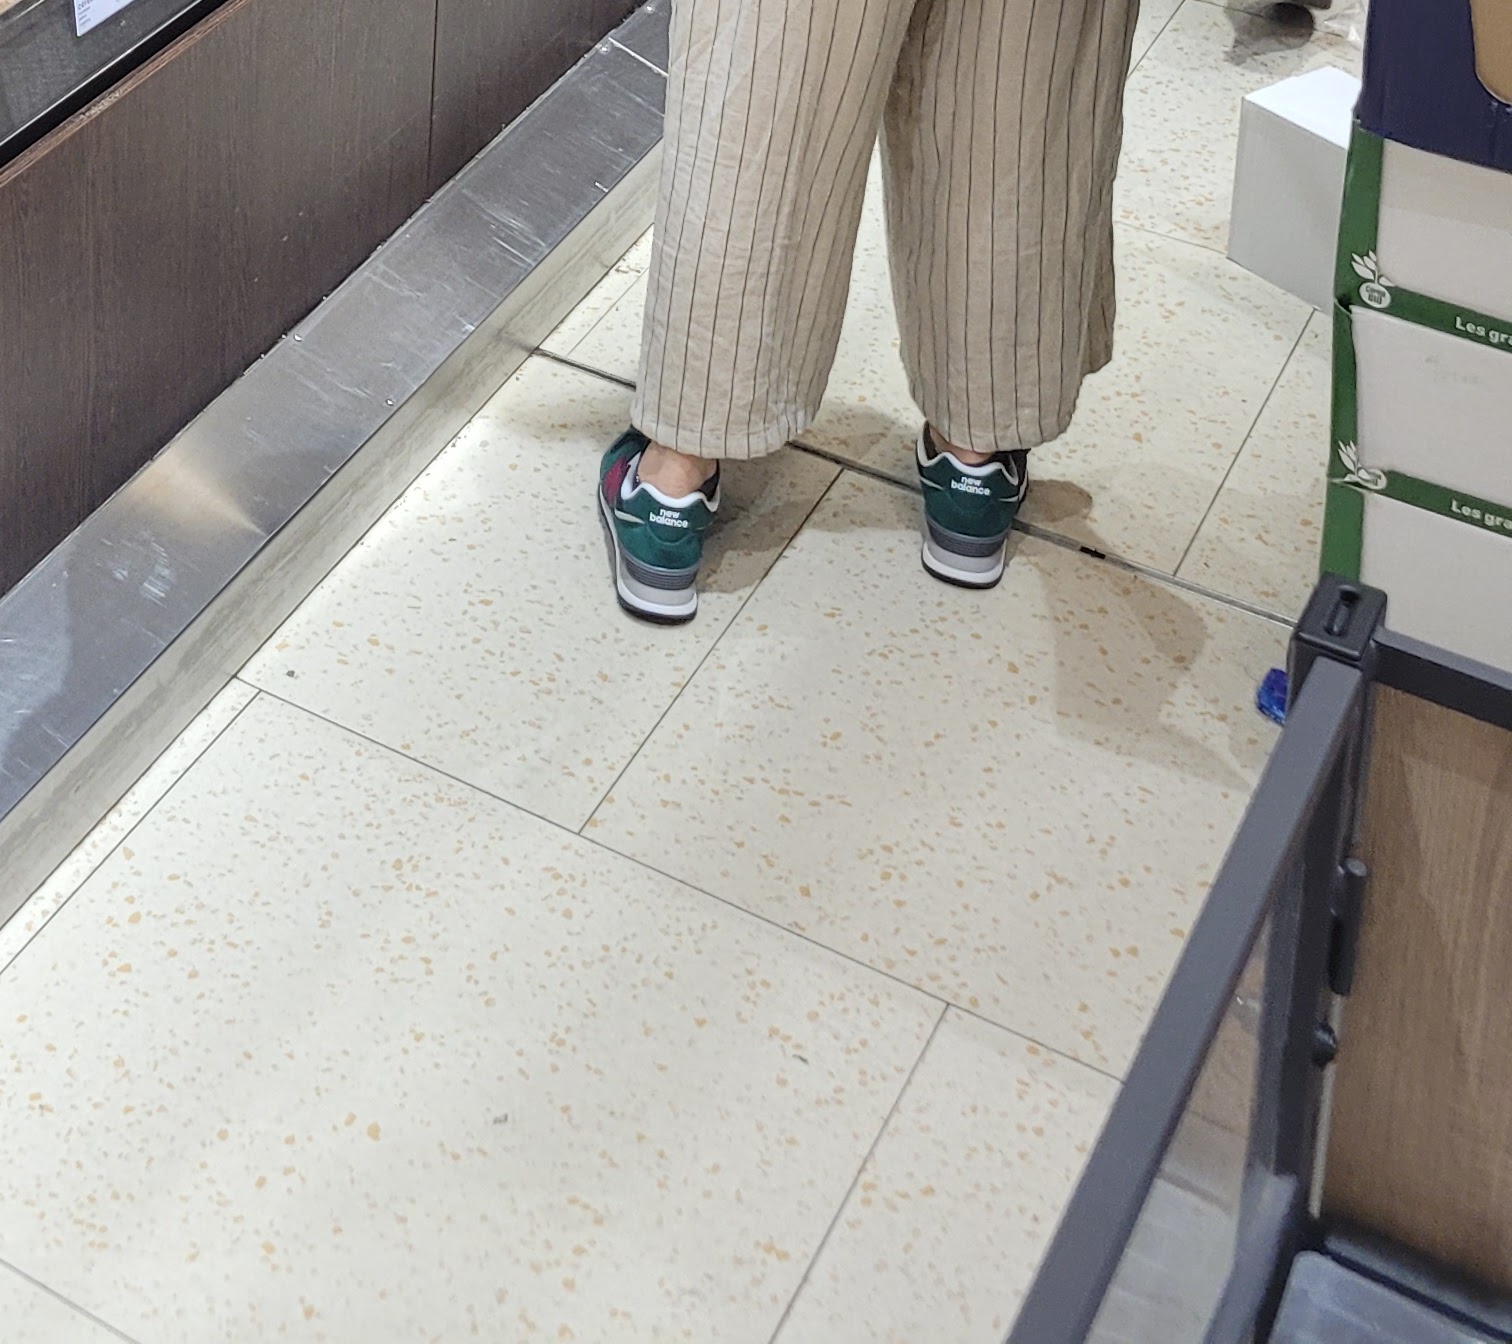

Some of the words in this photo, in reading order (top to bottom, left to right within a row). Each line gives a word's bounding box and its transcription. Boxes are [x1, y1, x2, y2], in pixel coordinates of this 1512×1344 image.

[1455, 316, 1486, 337] Les
[951, 481, 991, 496] balance
[960, 476, 981, 487] new
[659, 509, 680, 519] new
[1451, 498, 1481, 520] Les
[649, 513, 689, 529] balance
